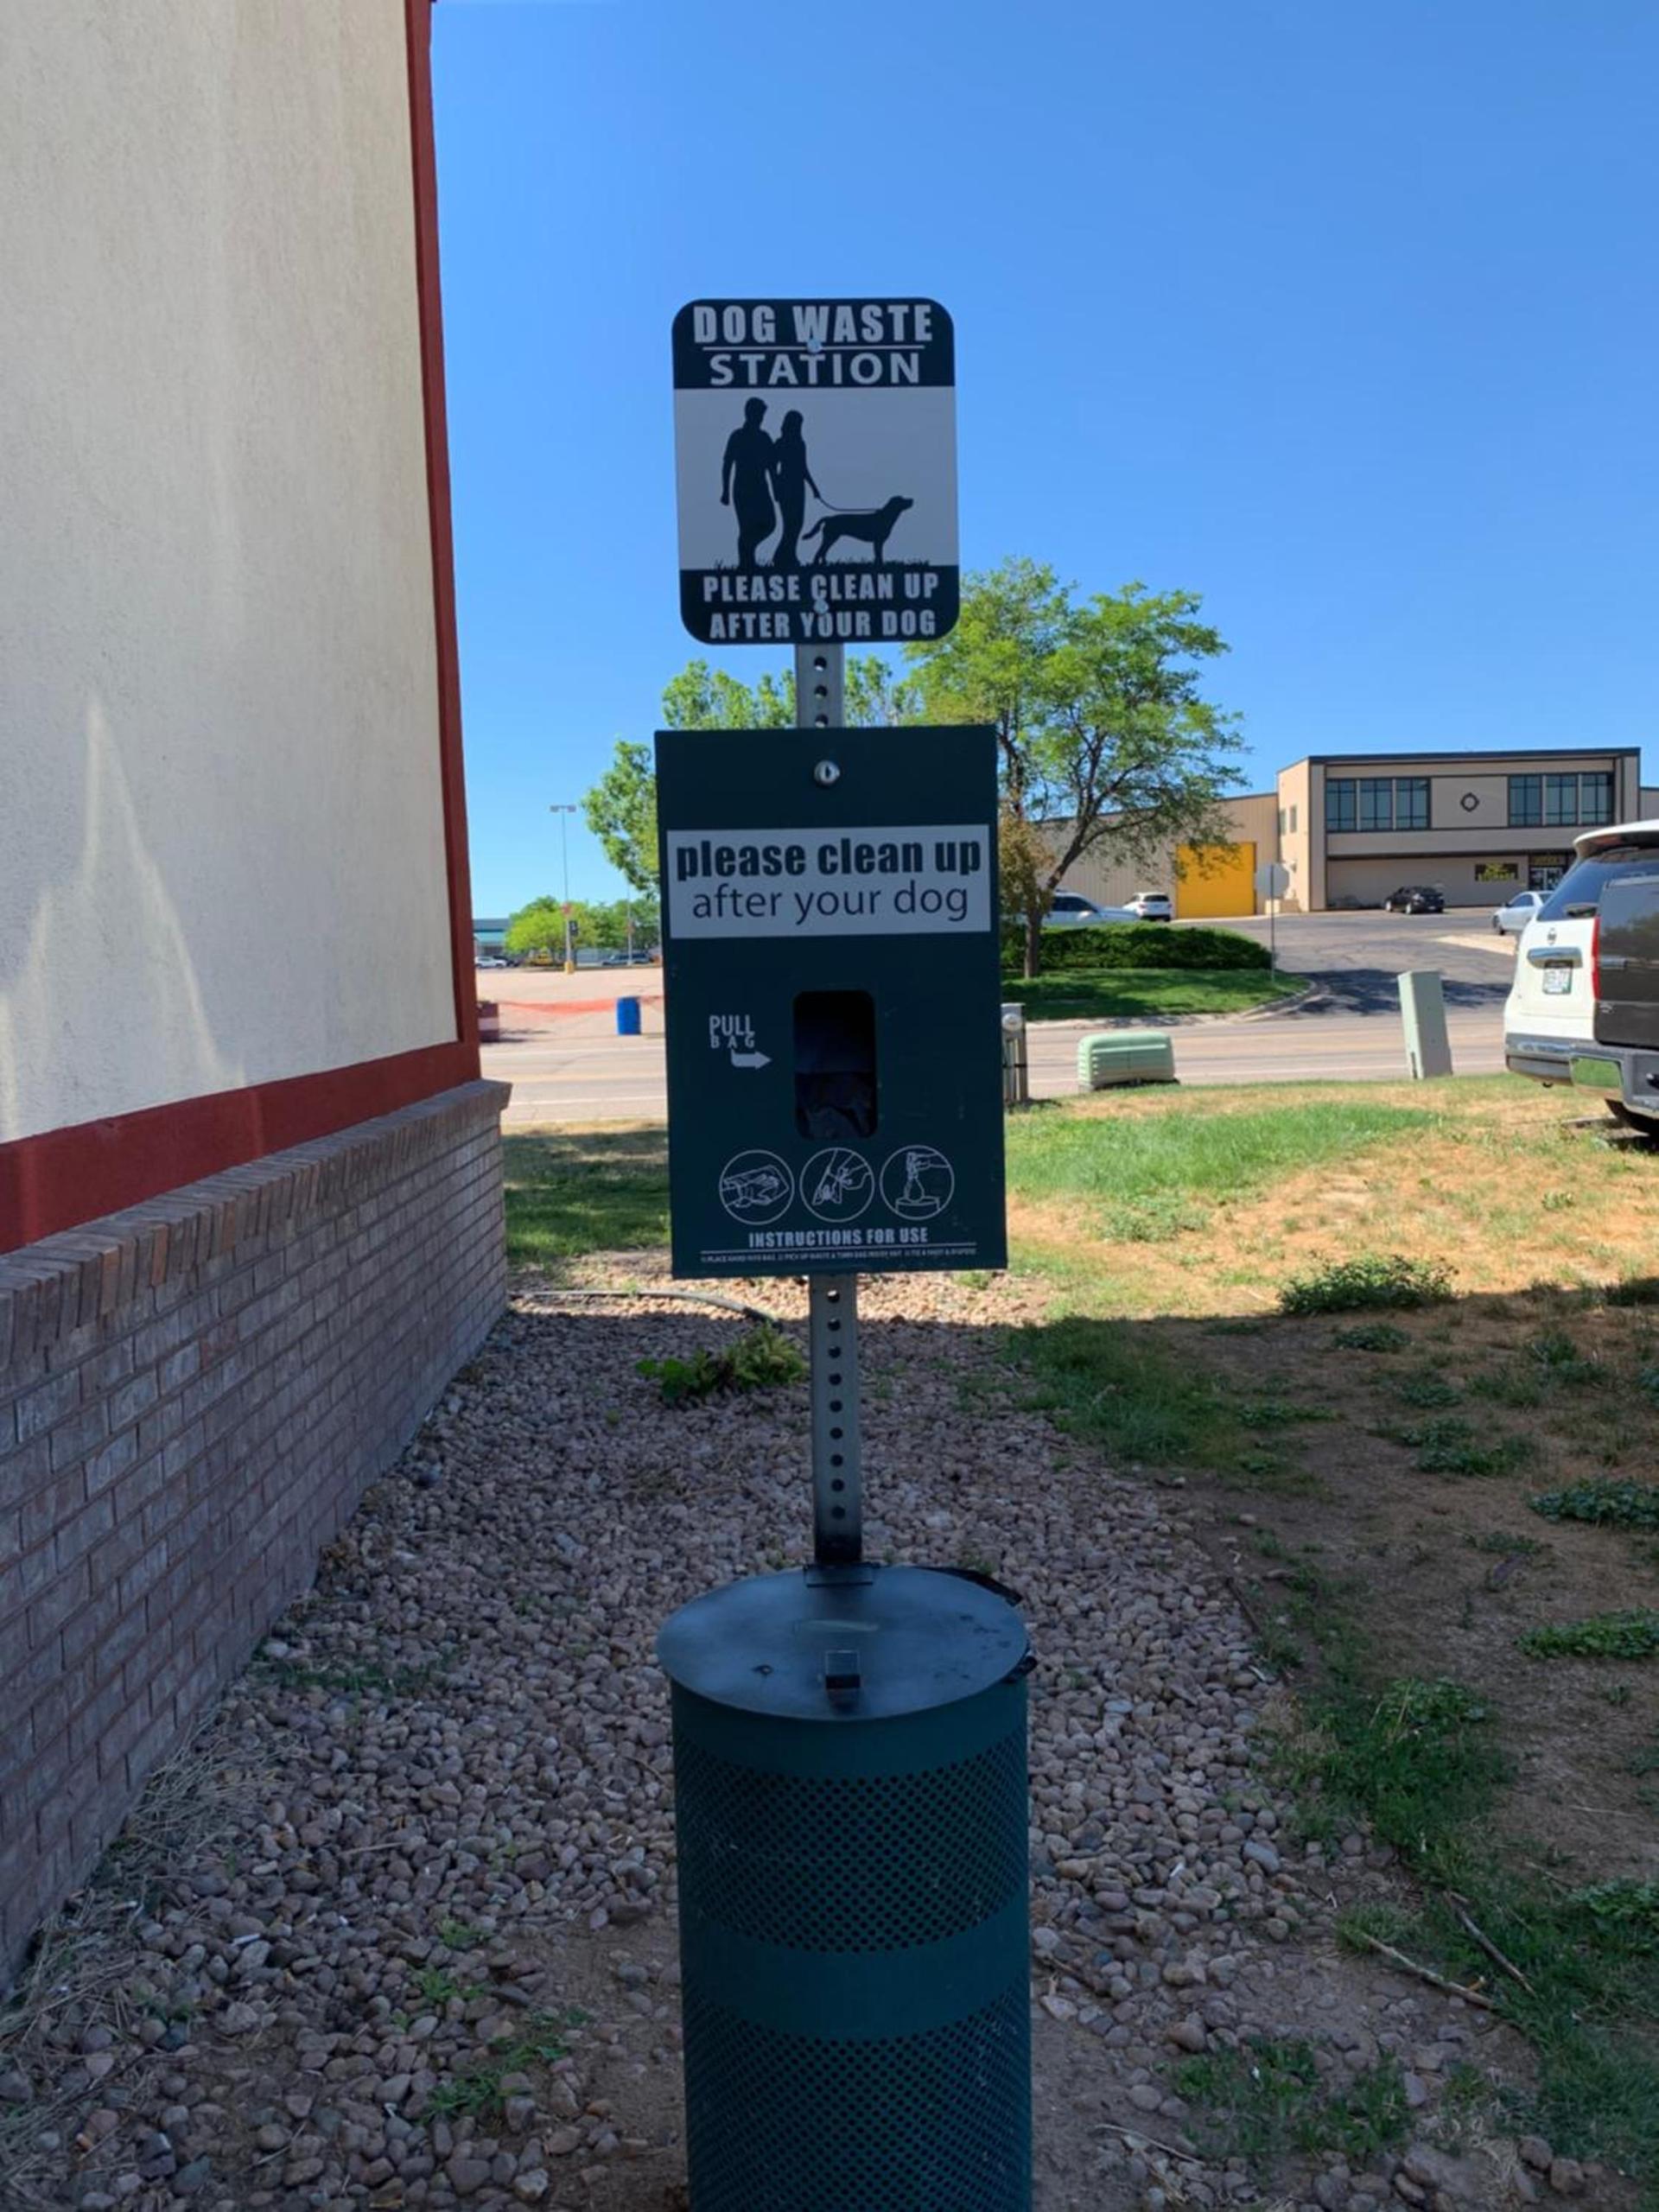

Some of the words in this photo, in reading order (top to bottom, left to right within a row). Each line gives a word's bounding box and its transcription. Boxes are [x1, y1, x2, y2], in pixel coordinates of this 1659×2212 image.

[694, 305, 776, 344] DOG
[792, 303, 932, 343] WASTE
[709, 352, 920, 386] STATION
[703, 575, 800, 602] PLEASE
[810, 573, 893, 602] CLEAN
[904, 572, 938, 599] UP
[709, 612, 790, 639] AFTER
[800, 611, 871, 638] YOUR
[881, 609, 936, 636] DOG
[676, 840, 806, 882] please
[817, 836, 923, 876] clean
[935, 839, 981, 875] up
[692, 882, 783, 919] after
[793, 889, 881, 926] your
[893, 880, 969, 922] dog
[709, 1014, 755, 1036] PULL
[710, 1036, 755, 1049] BAG
[748, 1230, 862, 1248] INSTRUCTIONS
[867, 1229, 895, 1244] FOR
[899, 1227, 929, 1243] USE
